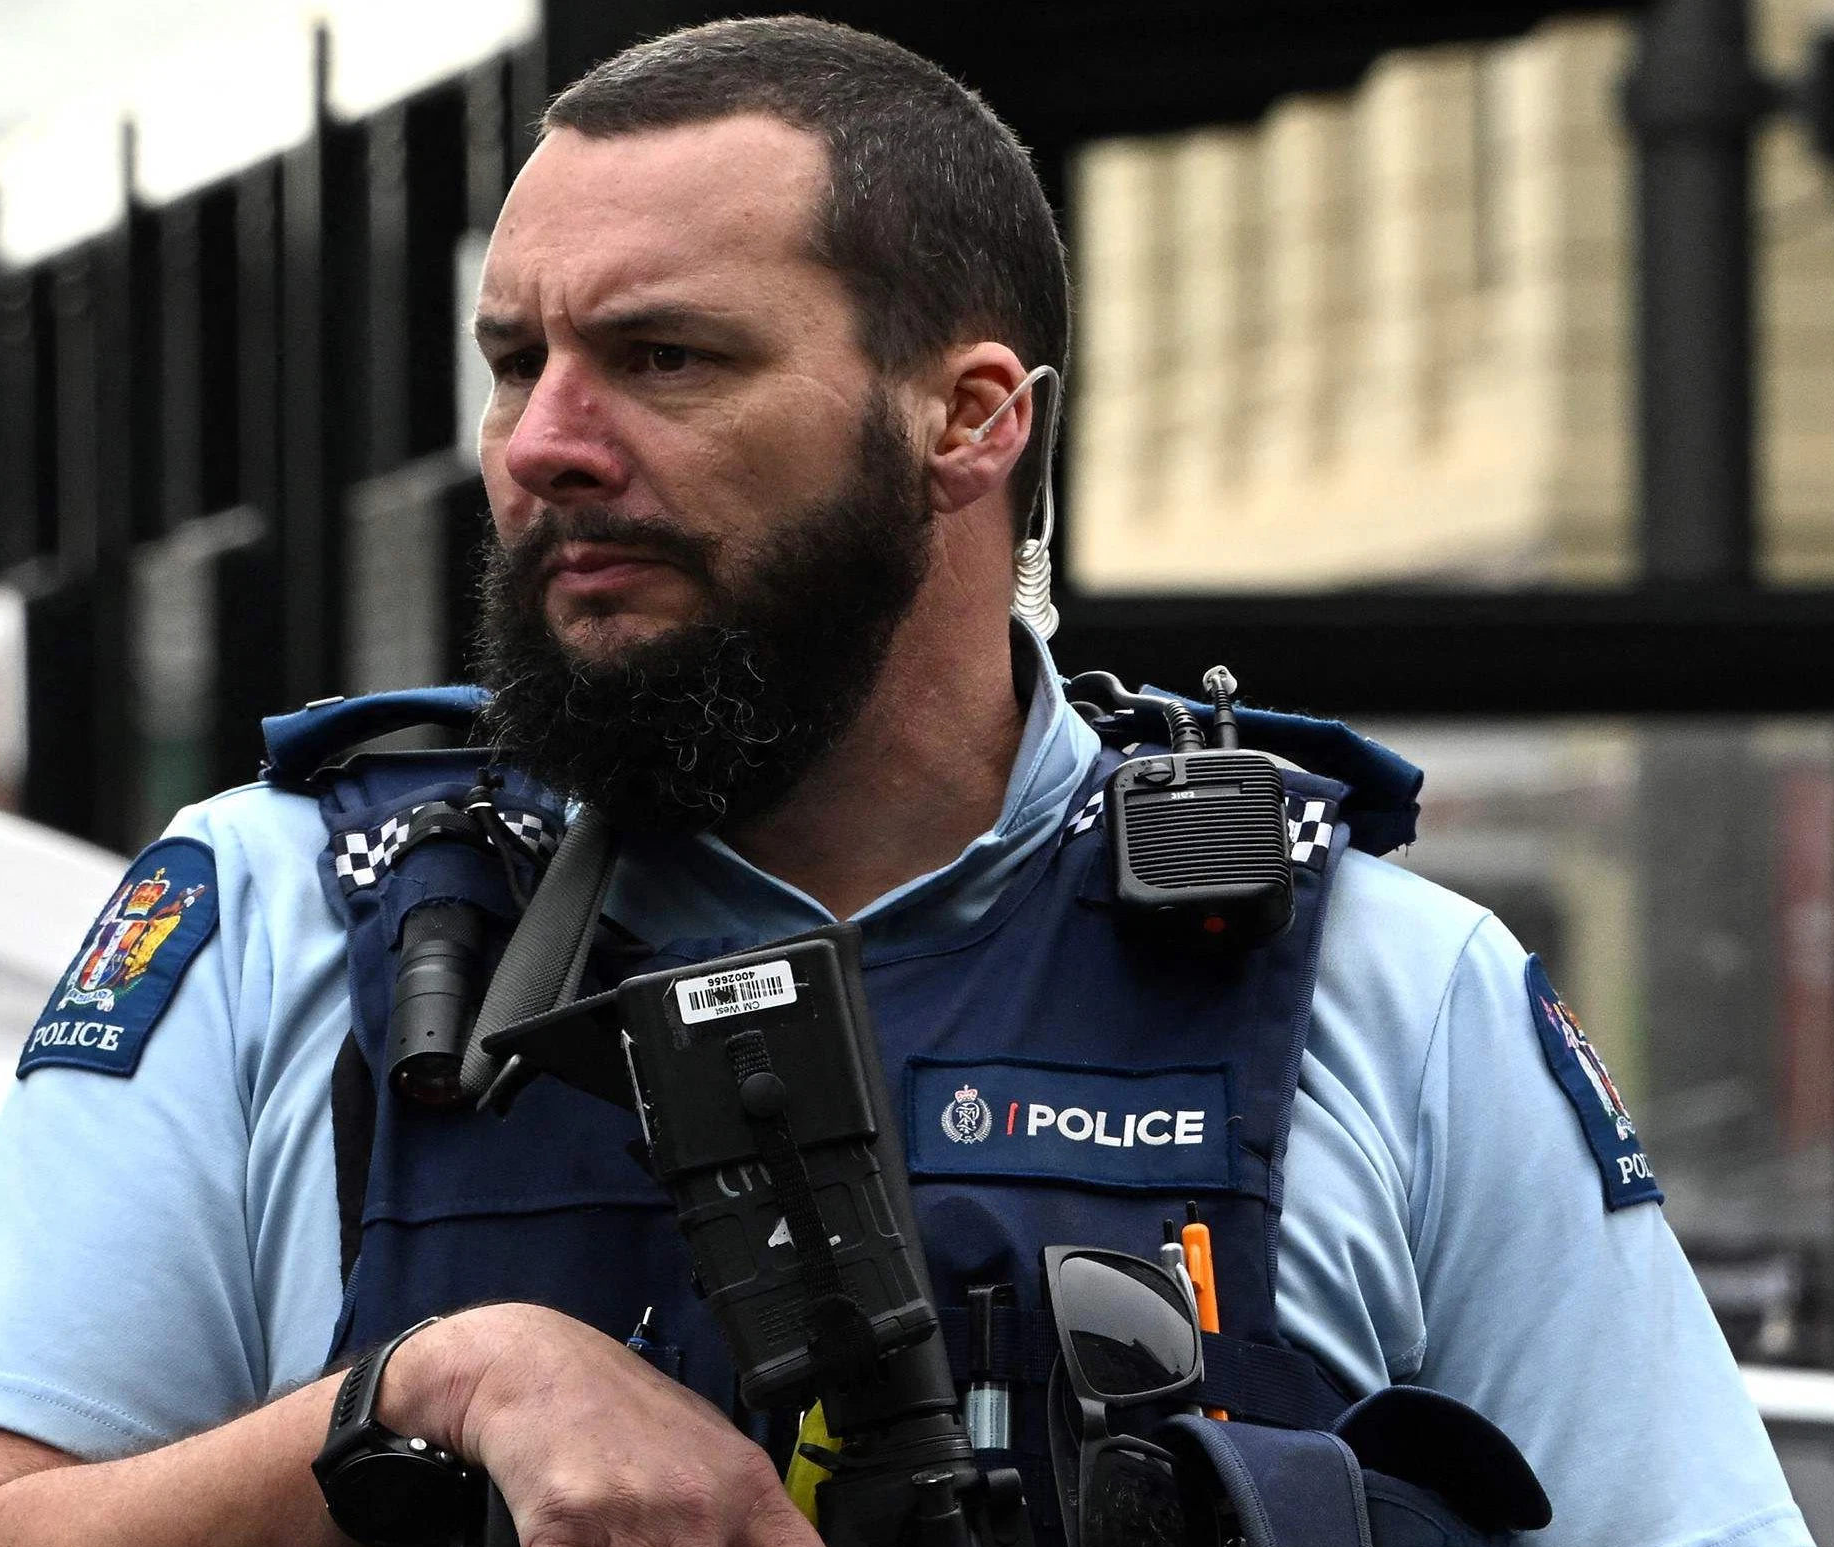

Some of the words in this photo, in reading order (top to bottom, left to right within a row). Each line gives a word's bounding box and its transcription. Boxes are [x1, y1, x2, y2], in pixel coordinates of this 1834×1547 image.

[715, 1004, 741, 1016] West
[744, 1001, 760, 1011] CM
[28, 1021, 124, 1054] POLICE
[1027, 1103, 1205, 1147] POLICE
